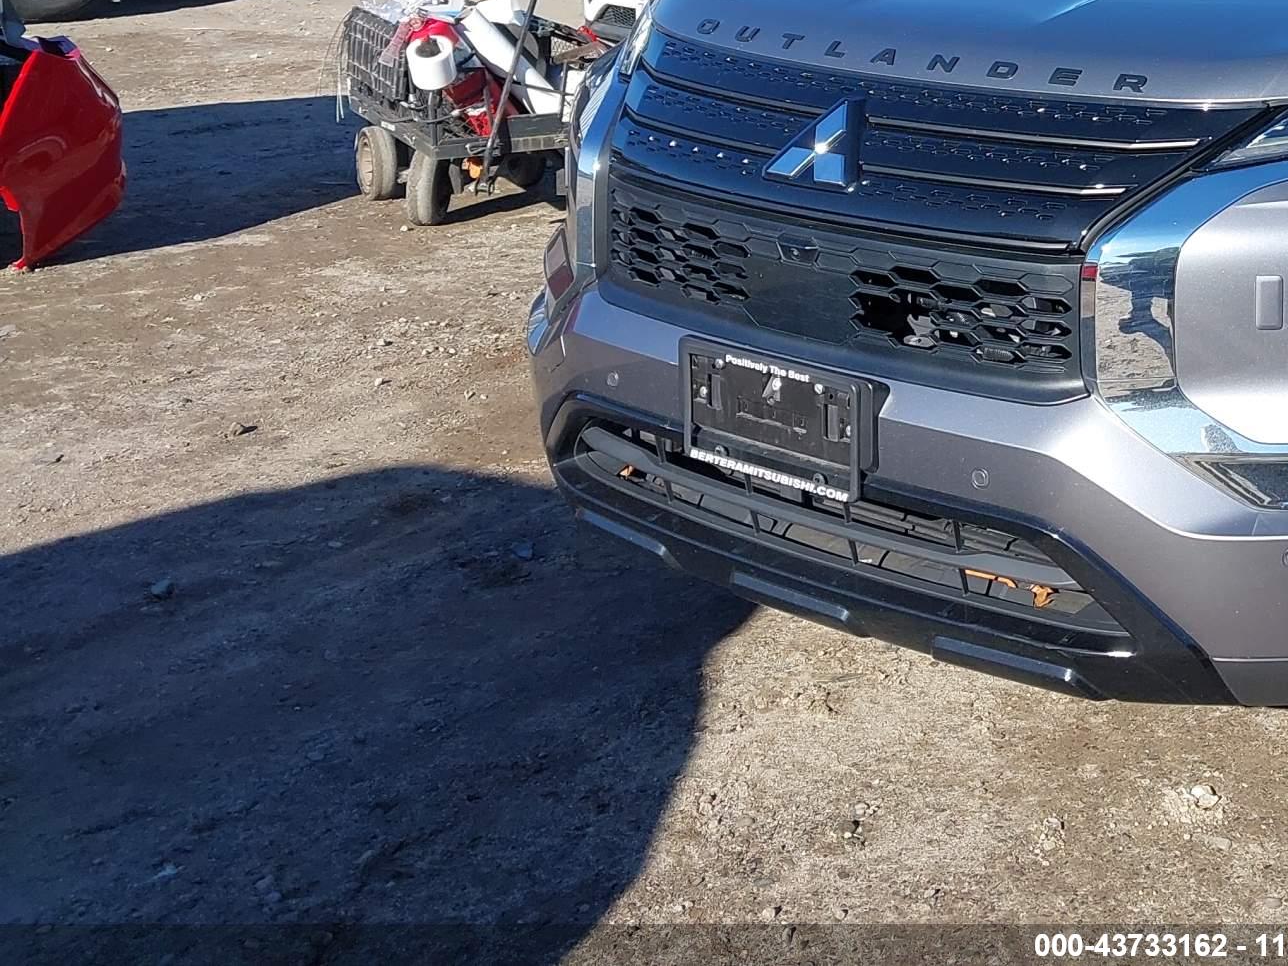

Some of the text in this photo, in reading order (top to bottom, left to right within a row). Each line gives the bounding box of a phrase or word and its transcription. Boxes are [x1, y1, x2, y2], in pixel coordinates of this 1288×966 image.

[695, 17, 1150, 94] OUTLANDER
[725, 354, 768, 374] Positively
[769, 365, 787, 377] The
[689, 448, 849, 503] BERTERAMITSUBISHI.COM
